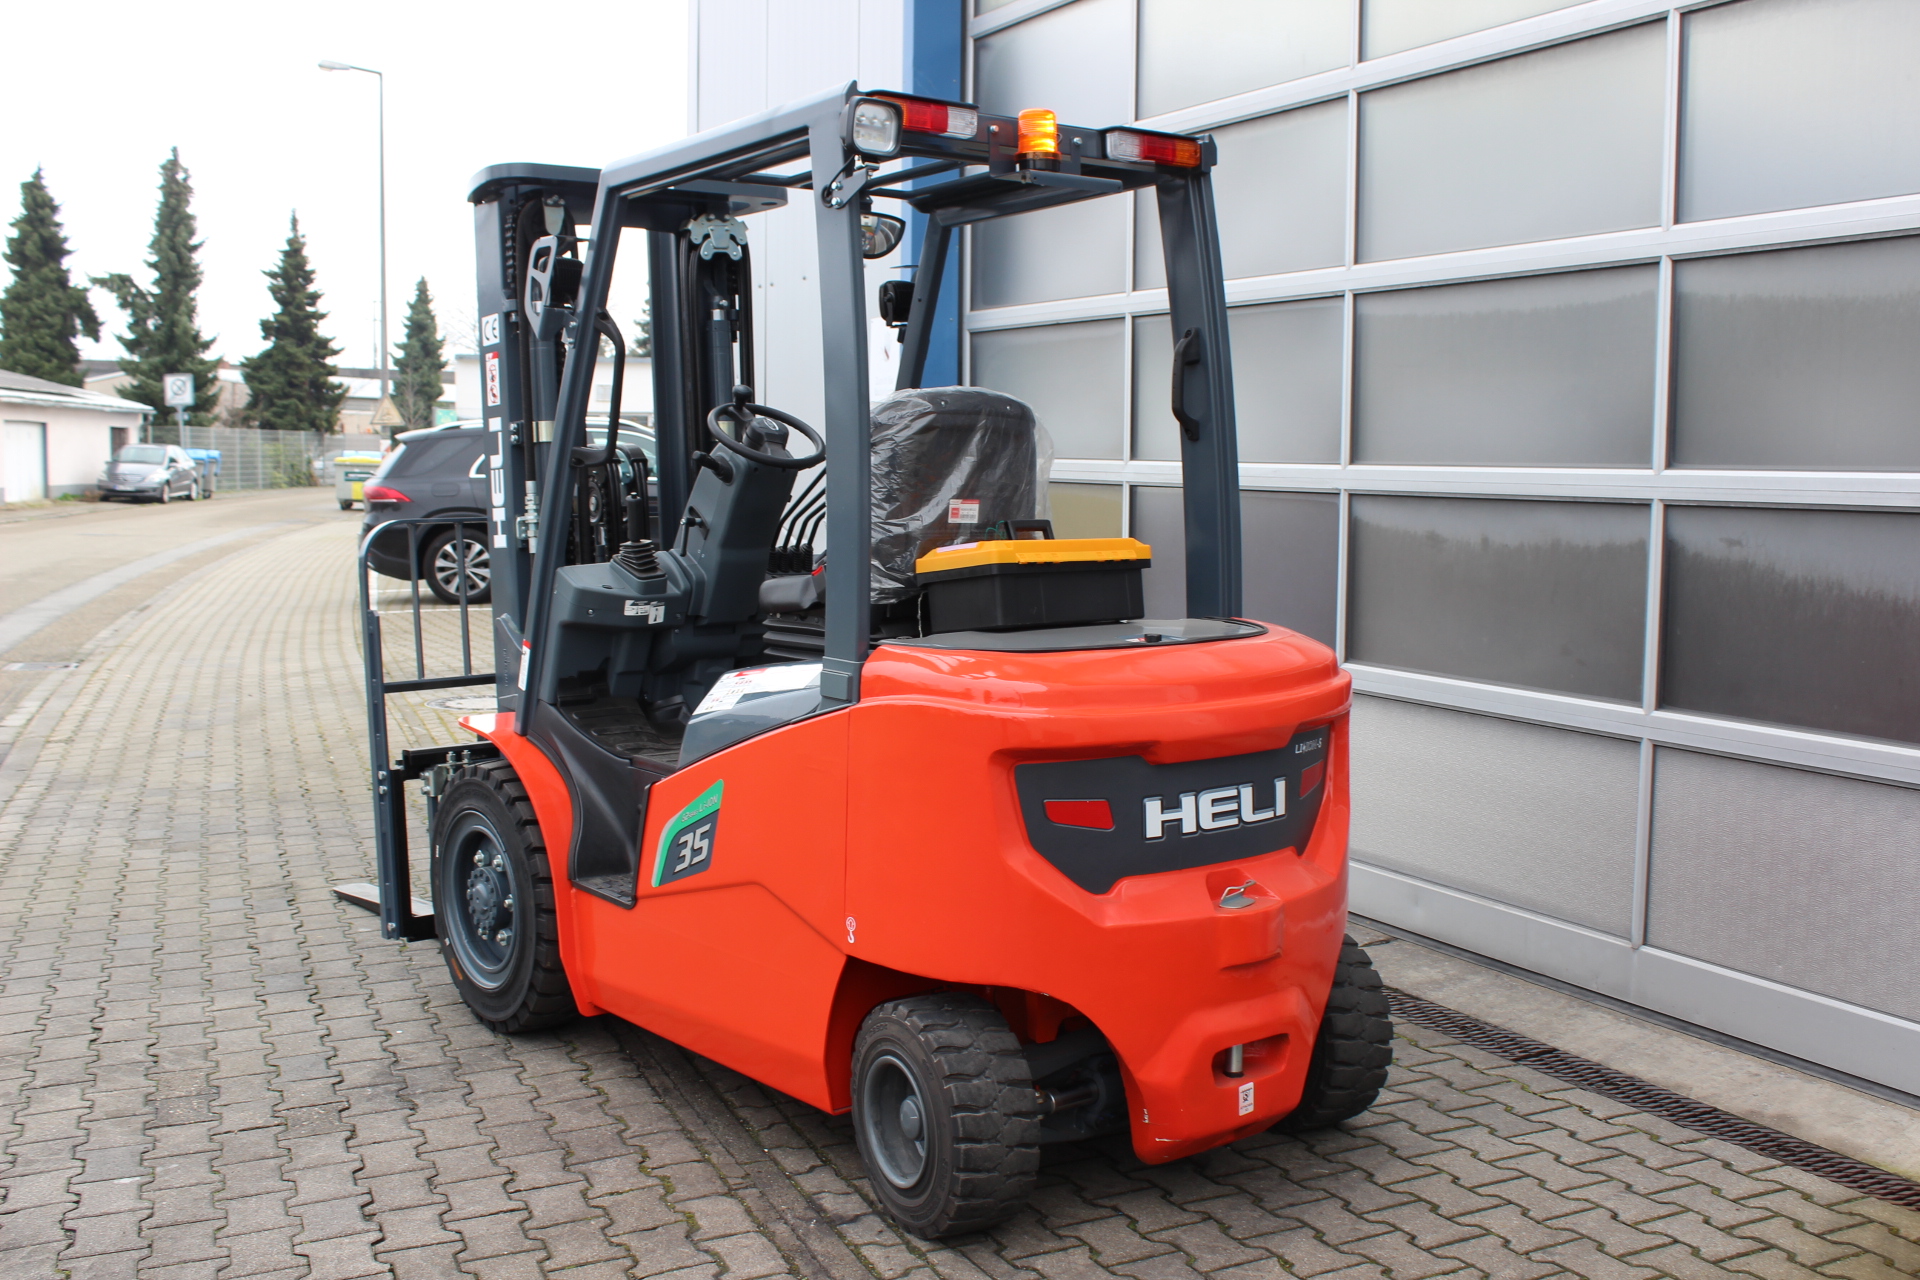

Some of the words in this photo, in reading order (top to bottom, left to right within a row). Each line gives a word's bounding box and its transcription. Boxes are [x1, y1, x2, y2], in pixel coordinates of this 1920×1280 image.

[488, 417, 507, 548] HELI
[1145, 777, 1287, 839] HELI
[674, 823, 711, 873] 35
